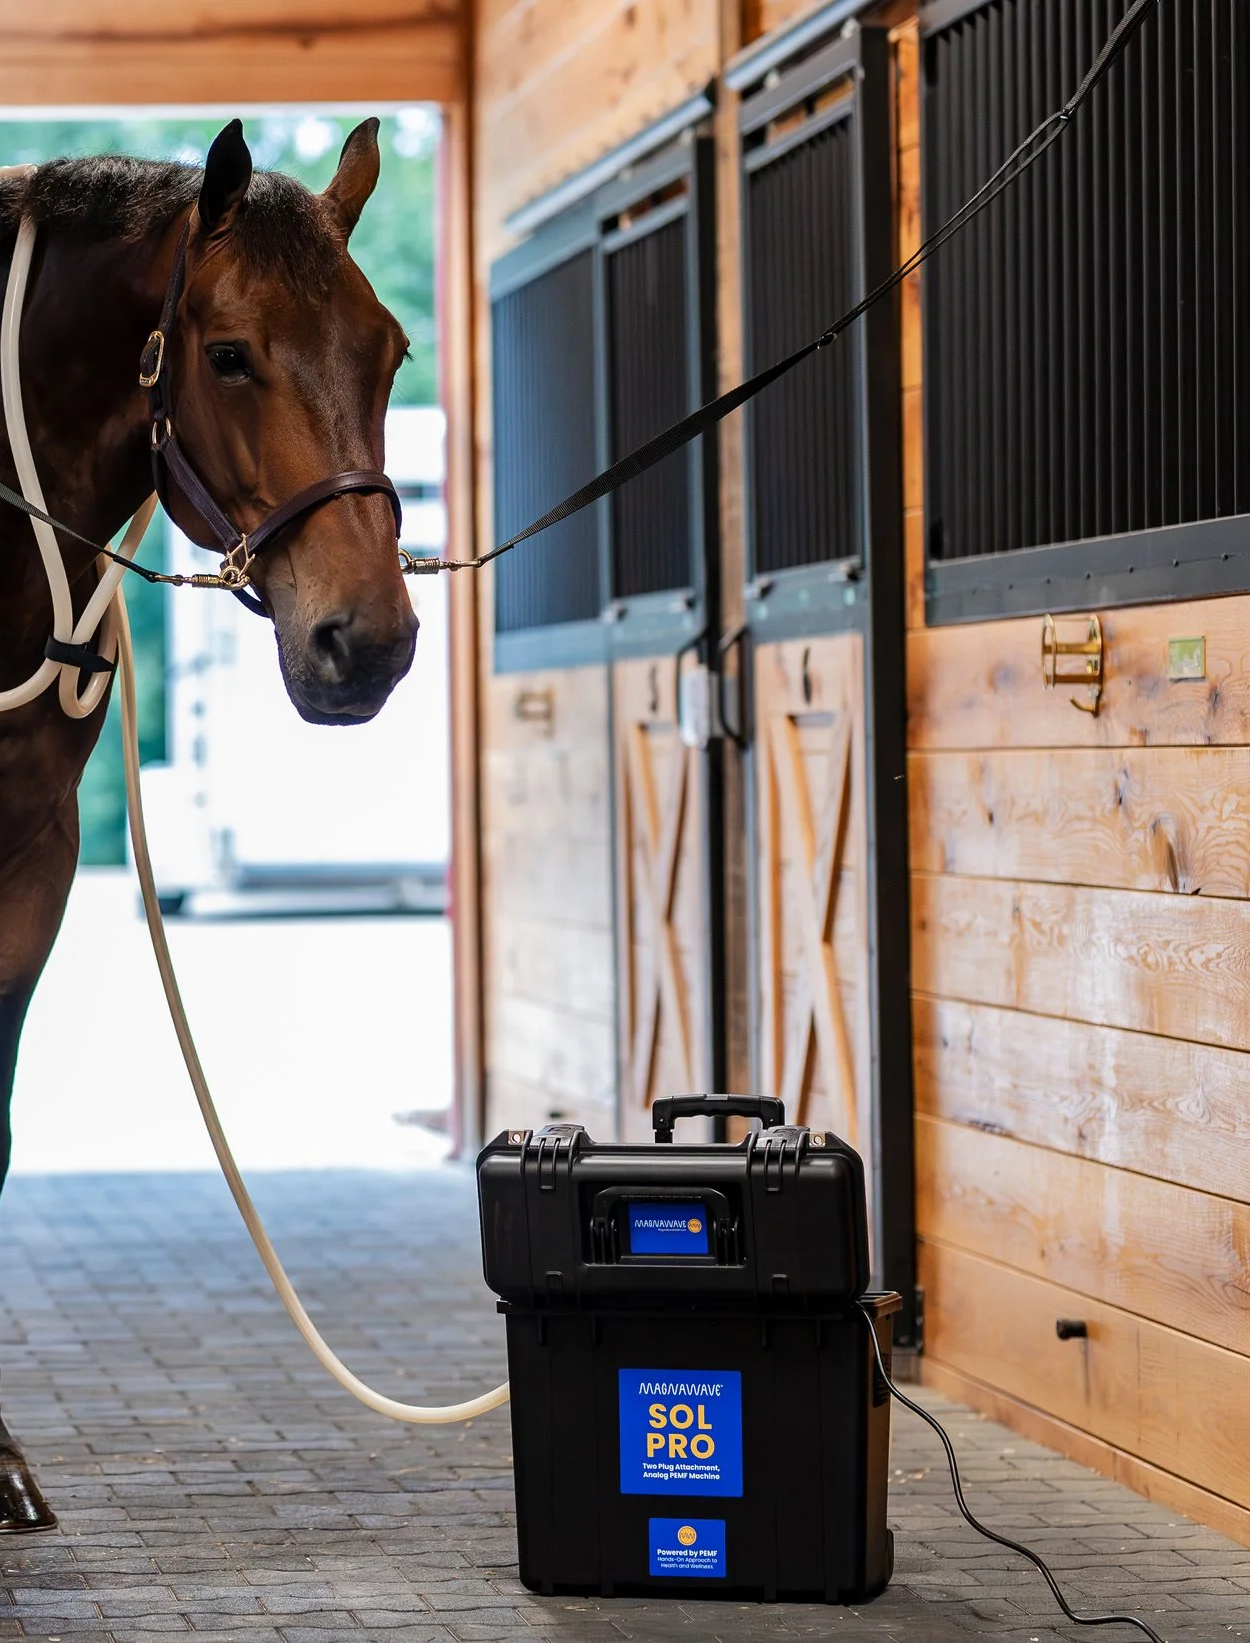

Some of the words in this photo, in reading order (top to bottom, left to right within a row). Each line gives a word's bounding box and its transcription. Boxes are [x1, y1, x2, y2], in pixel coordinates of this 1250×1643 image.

[648, 1403, 713, 1430] SOL
[646, 1432, 715, 1459] PRO
[658, 1463, 674, 1472] Plug
[675, 1464, 721, 1472] Attachment,
[643, 1472, 669, 1480] Analog
[689, 1550, 699, 1558] by
